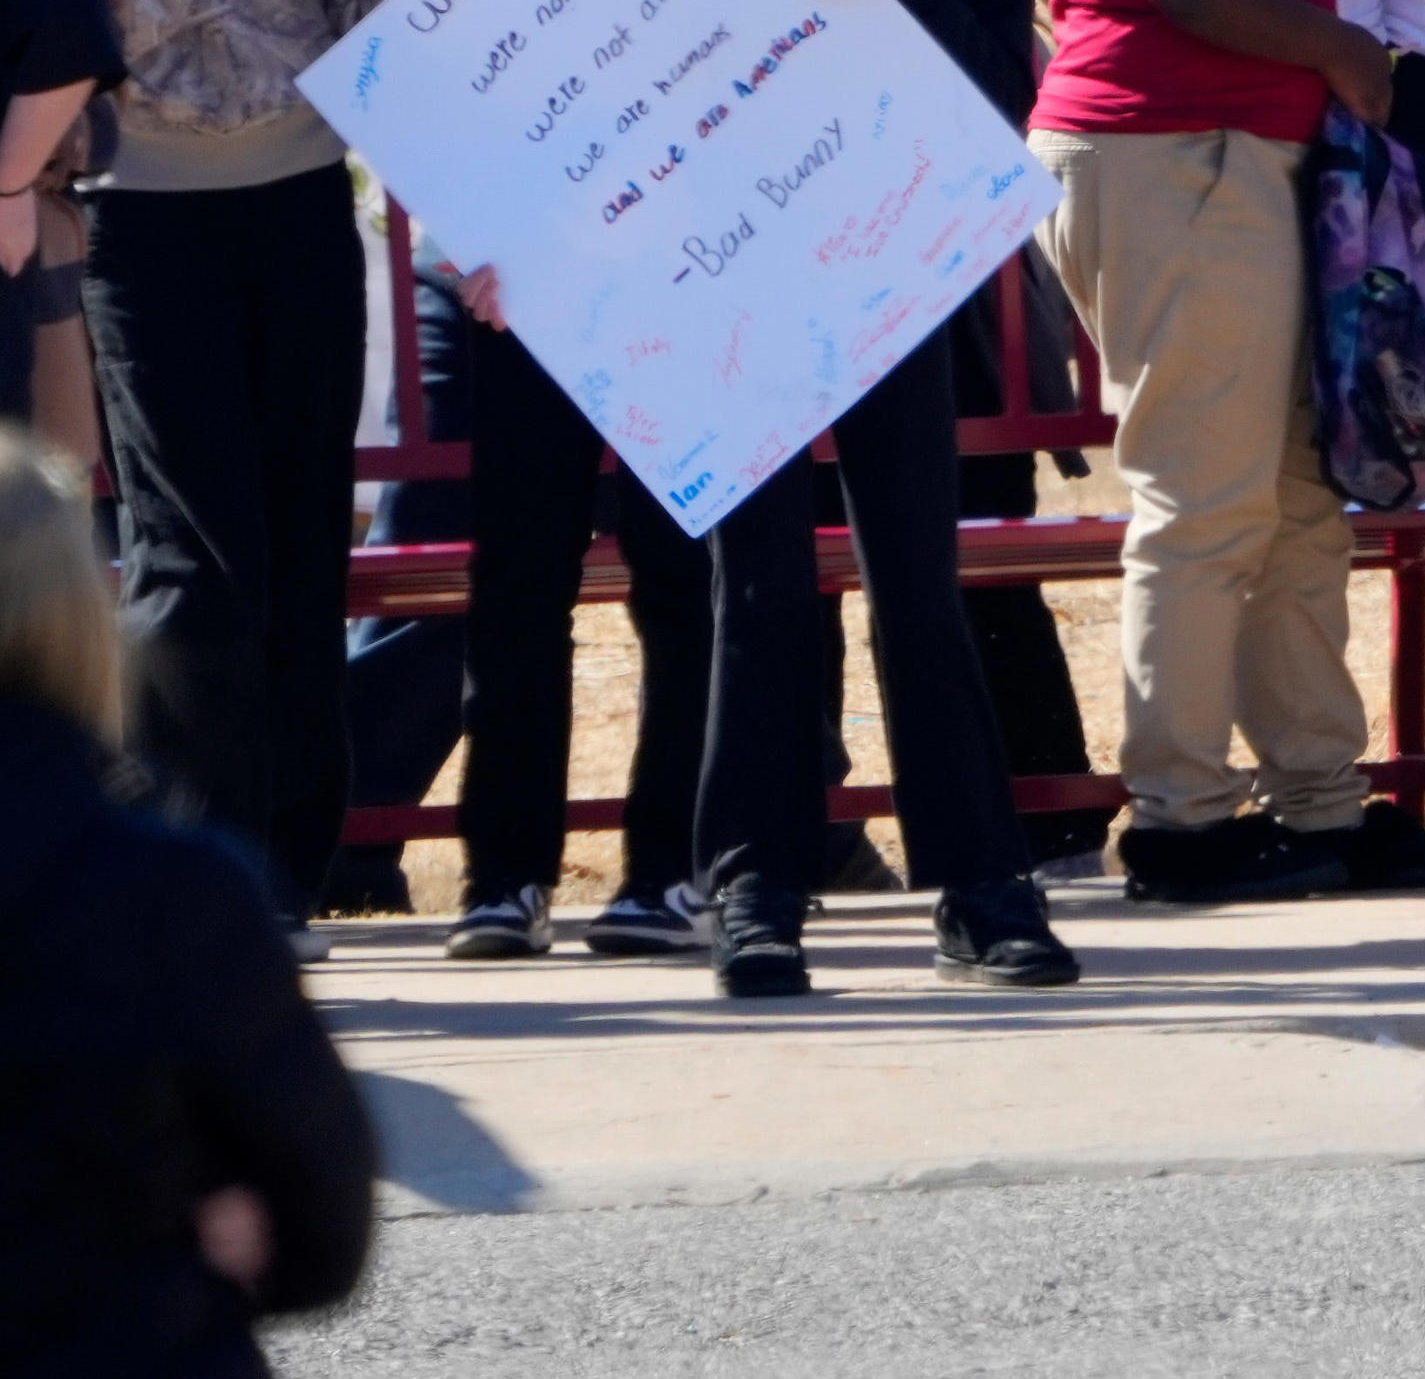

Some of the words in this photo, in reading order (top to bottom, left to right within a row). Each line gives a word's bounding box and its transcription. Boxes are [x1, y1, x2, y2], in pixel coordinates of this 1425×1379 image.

[471, 28, 527, 97] were
[525, 74, 586, 144] were
[592, 28, 634, 73] not
[565, 139, 606, 185] we
[616, 102, 650, 134] are
[653, 21, 733, 97] humans
[601, 181, 644, 225] and
[649, 143, 686, 185] we
[737, 11, 827, 100] Americans
[757, 116, 846, 213] Bunny
[669, 471, 714, 510] Ian
